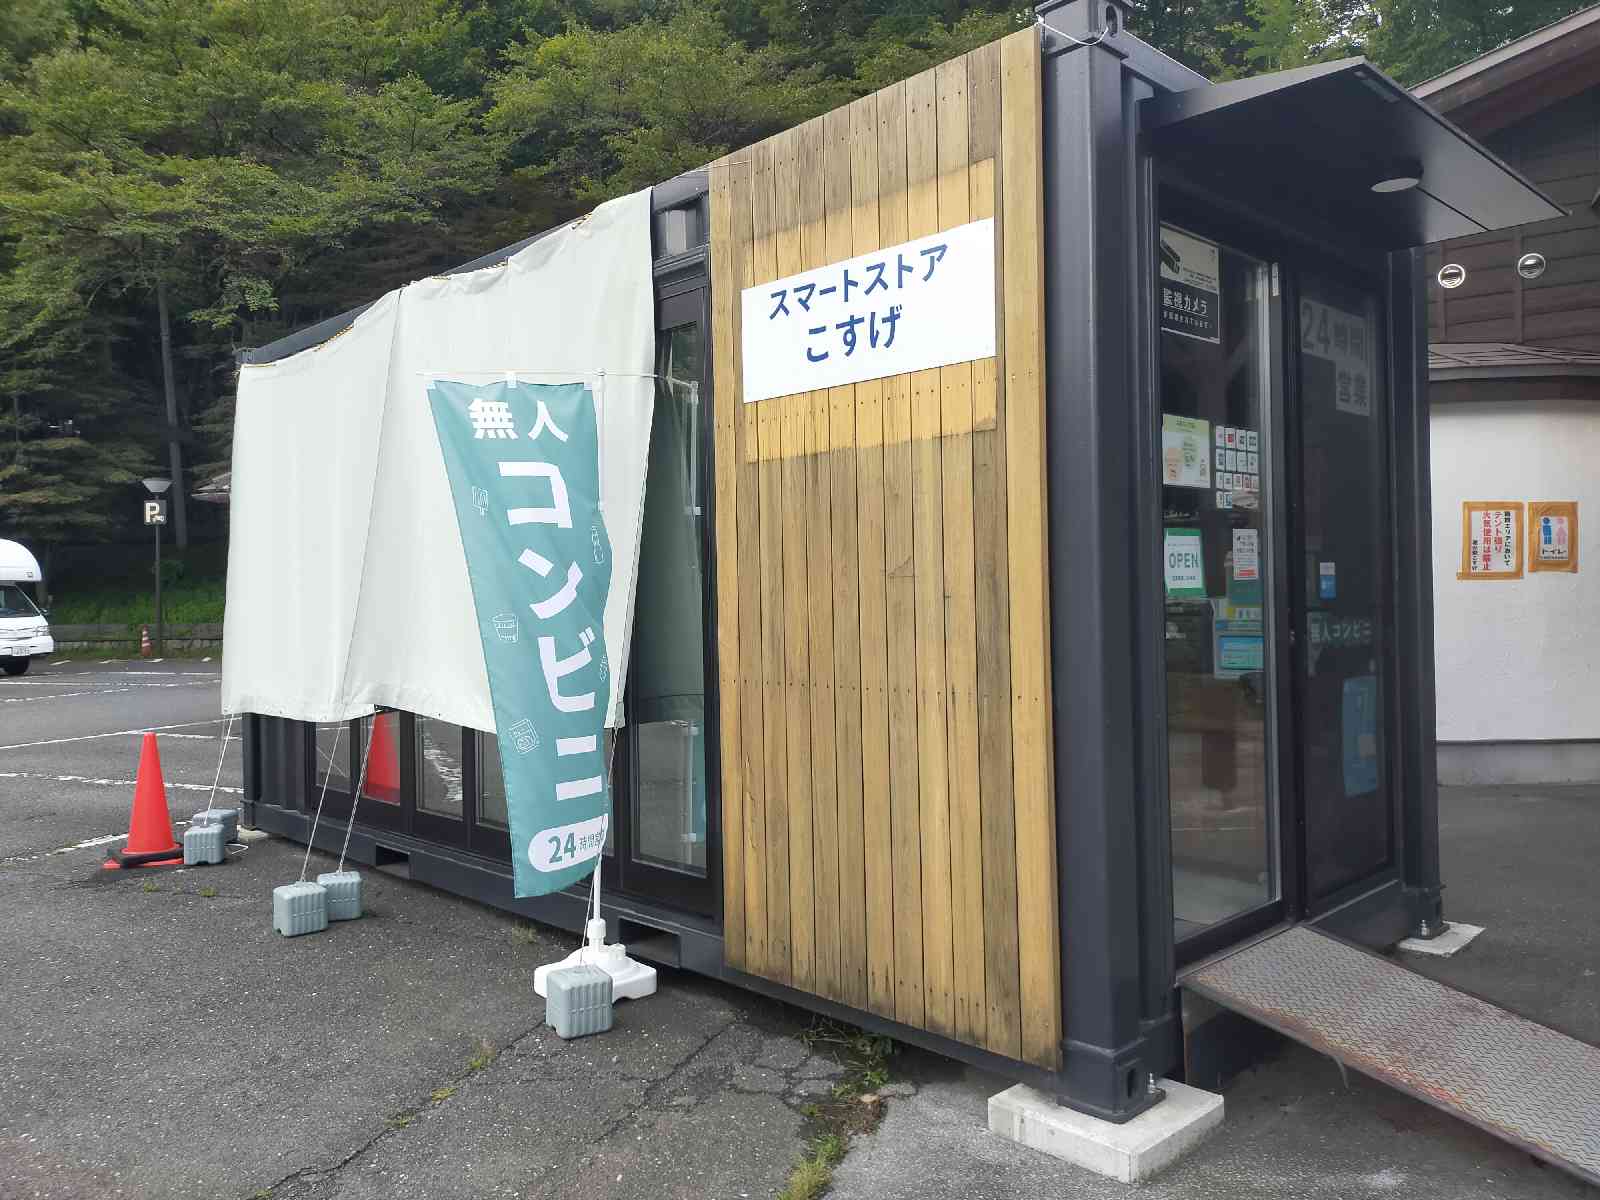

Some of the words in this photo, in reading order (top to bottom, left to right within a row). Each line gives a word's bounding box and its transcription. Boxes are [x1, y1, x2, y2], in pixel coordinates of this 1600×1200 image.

[769, 243, 948, 320] スマートストア
[1163, 287, 1209, 316] 監視カメラ
[806, 304, 903, 363] こすげ
[468, 398, 569, 443] 無人
[1168, 552, 1200, 569] OPEN
[497, 460, 603, 801] コンビニ
